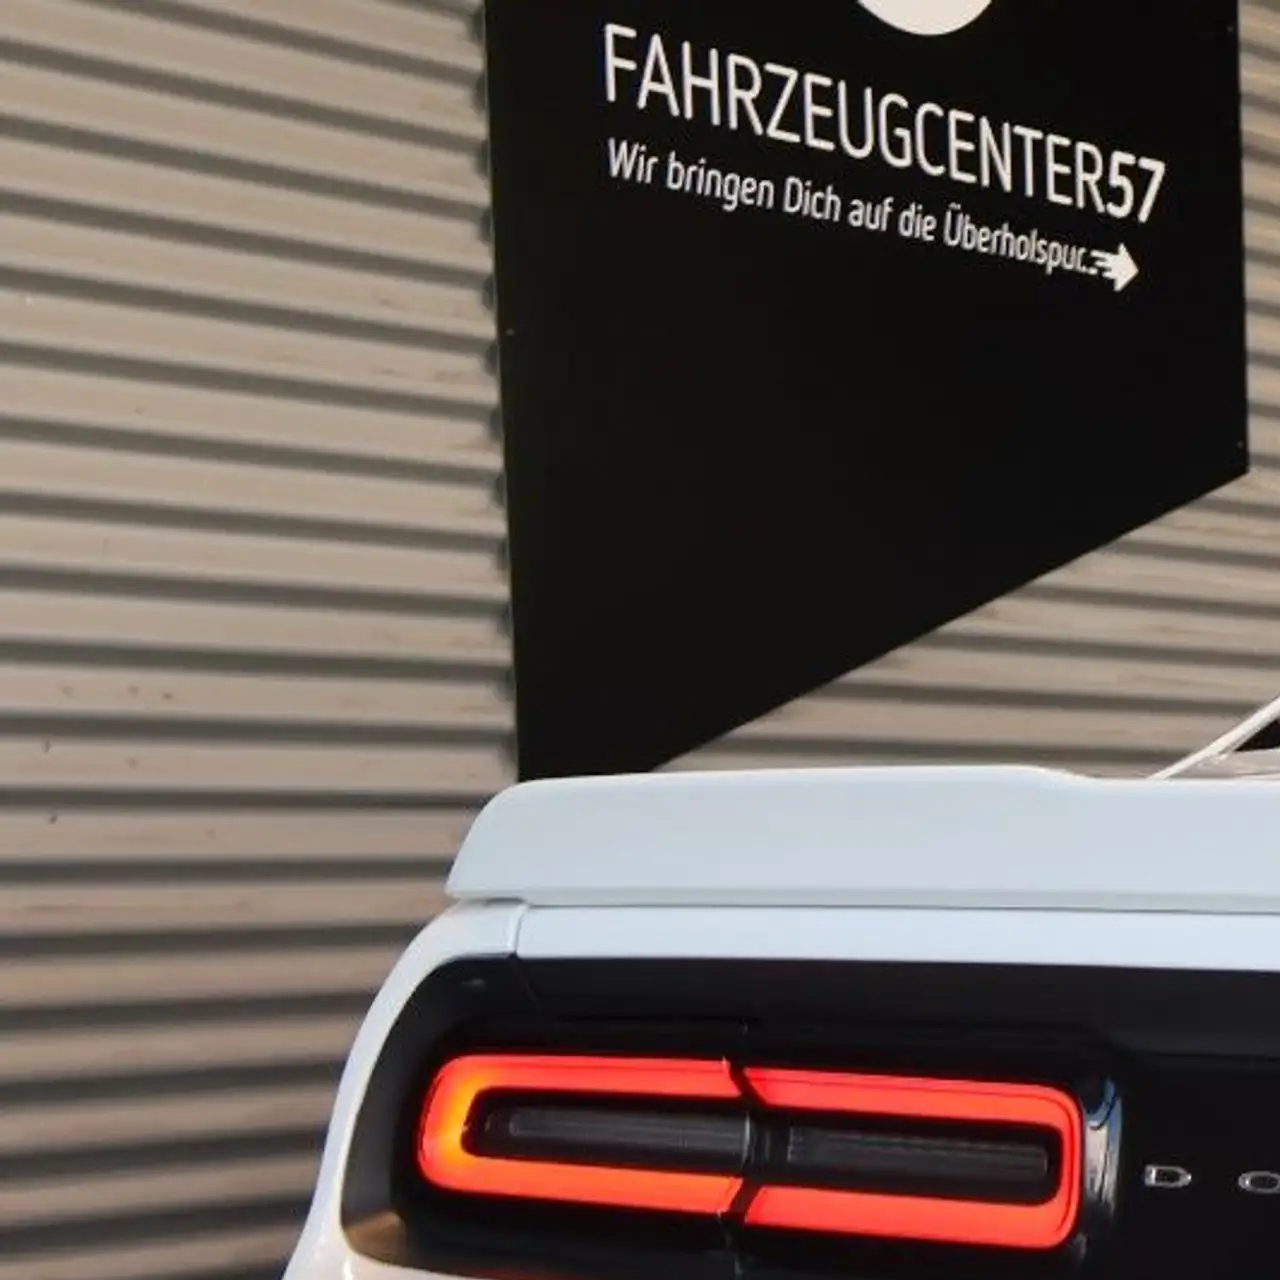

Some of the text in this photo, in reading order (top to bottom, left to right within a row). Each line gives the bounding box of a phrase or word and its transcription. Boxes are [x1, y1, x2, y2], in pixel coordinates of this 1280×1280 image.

[604, 23, 1166, 223] FAHRZEUGCENTER57
[608, 137, 659, 184] Wir
[666, 150, 775, 212] bringen
[783, 175, 842, 222] Dich
[848, 196, 893, 232] auf
[899, 202, 937, 242] die
